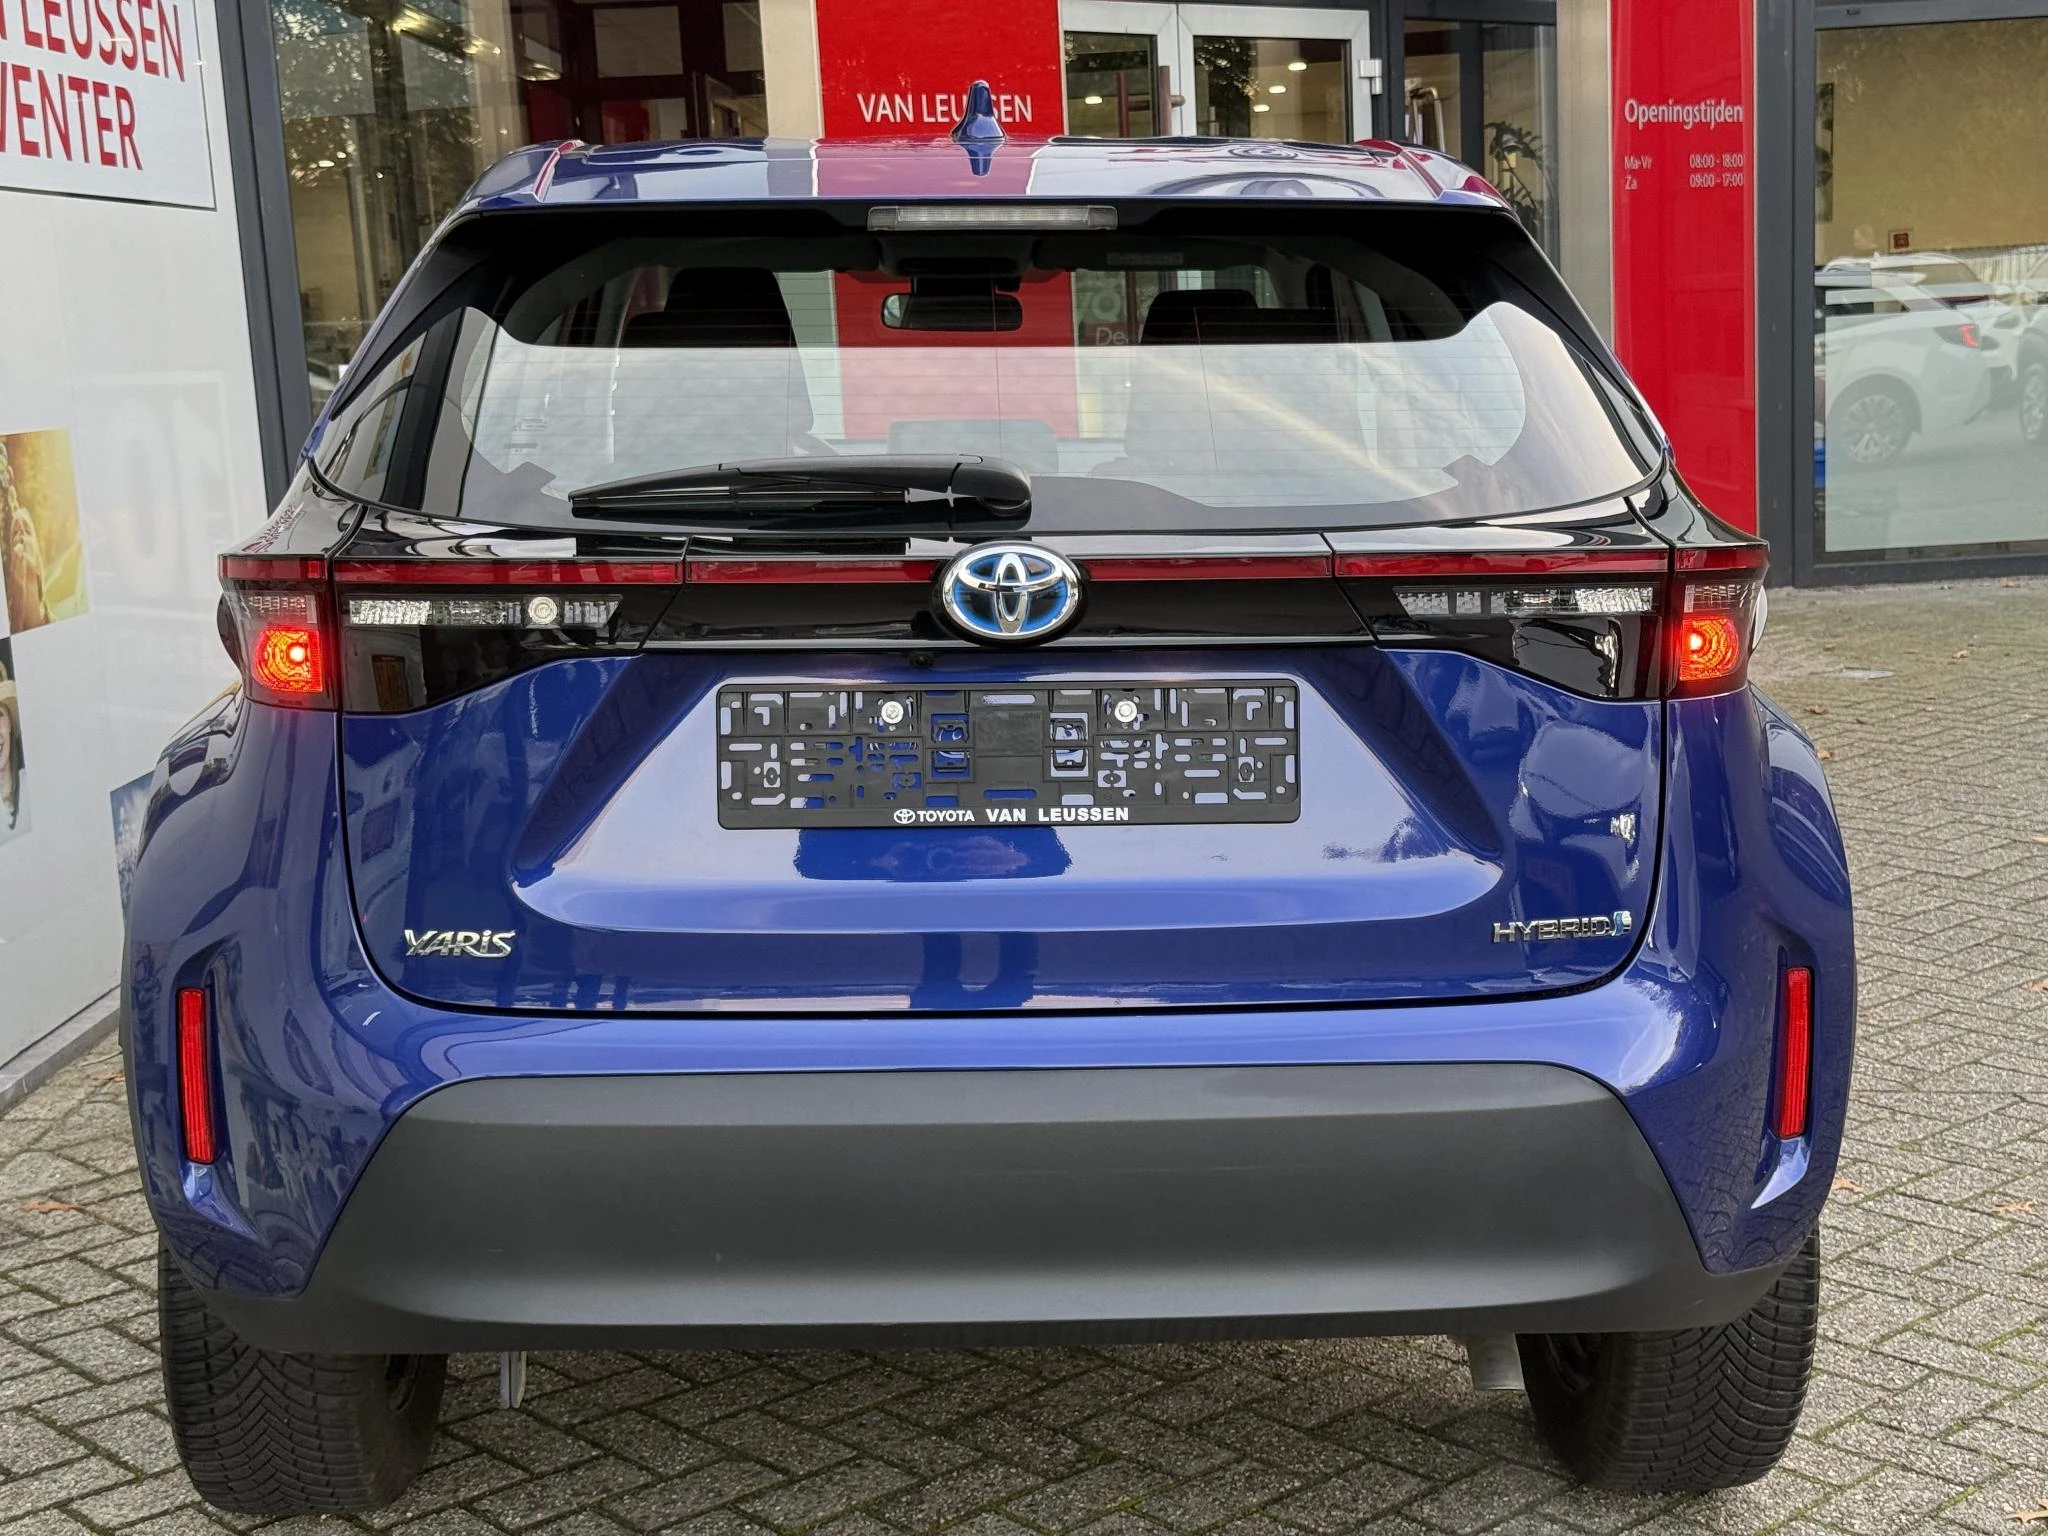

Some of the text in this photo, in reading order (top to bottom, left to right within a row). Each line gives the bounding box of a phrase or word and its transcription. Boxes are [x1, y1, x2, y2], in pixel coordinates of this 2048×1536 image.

[857, 93, 914, 123] VAN
[1624, 98, 1744, 130] Openingstijden
[1624, 156, 1652, 170] Ma-Vr
[1689, 154, 1715, 168] 08:00
[1722, 153, 1744, 168] 18:00
[1624, 175, 1638, 190] Za
[1689, 173, 1715, 188] 09:00
[1722, 172, 1744, 187] 17:00
[917, 807, 1129, 823] TOYOTA VAN LEUSSEN
[1493, 915, 1611, 943] HYBRID
